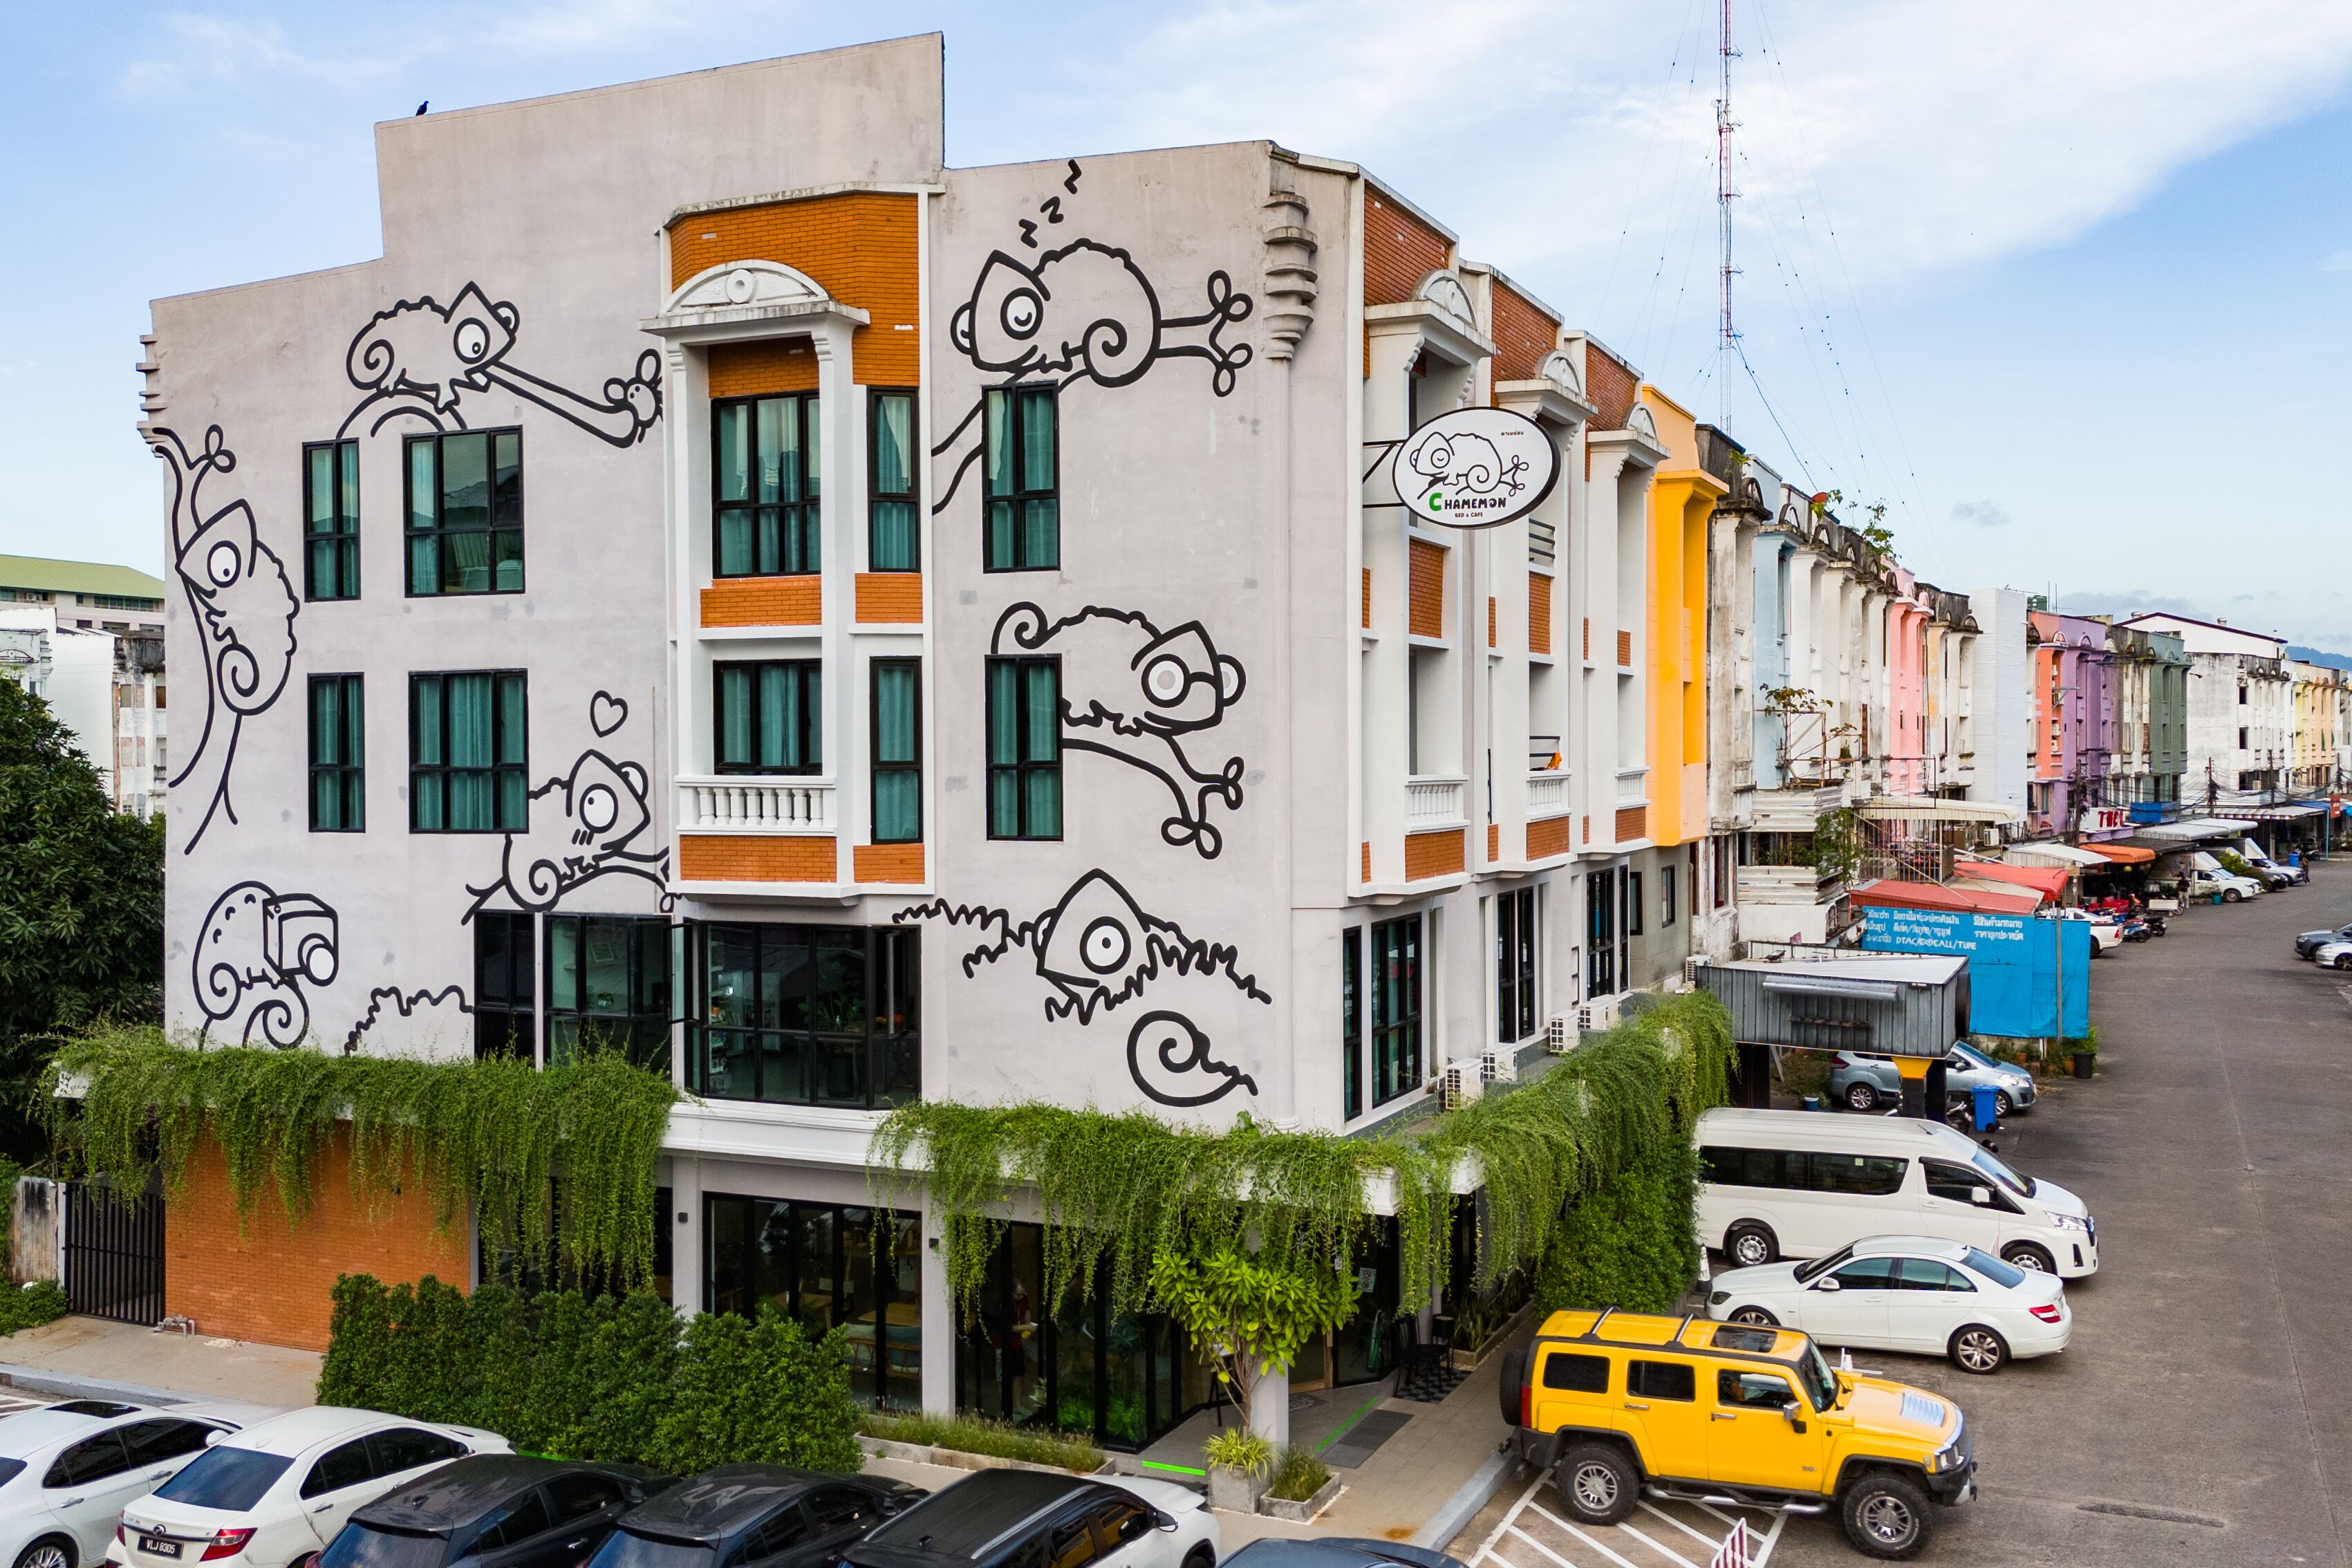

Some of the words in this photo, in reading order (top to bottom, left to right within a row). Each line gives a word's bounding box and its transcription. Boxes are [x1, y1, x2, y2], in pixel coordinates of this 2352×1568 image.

[1429, 492, 1506, 512] CHAMEMON
[147, 1540, 158, 1550] VLJ
[160, 1542, 176, 1554] 8305
